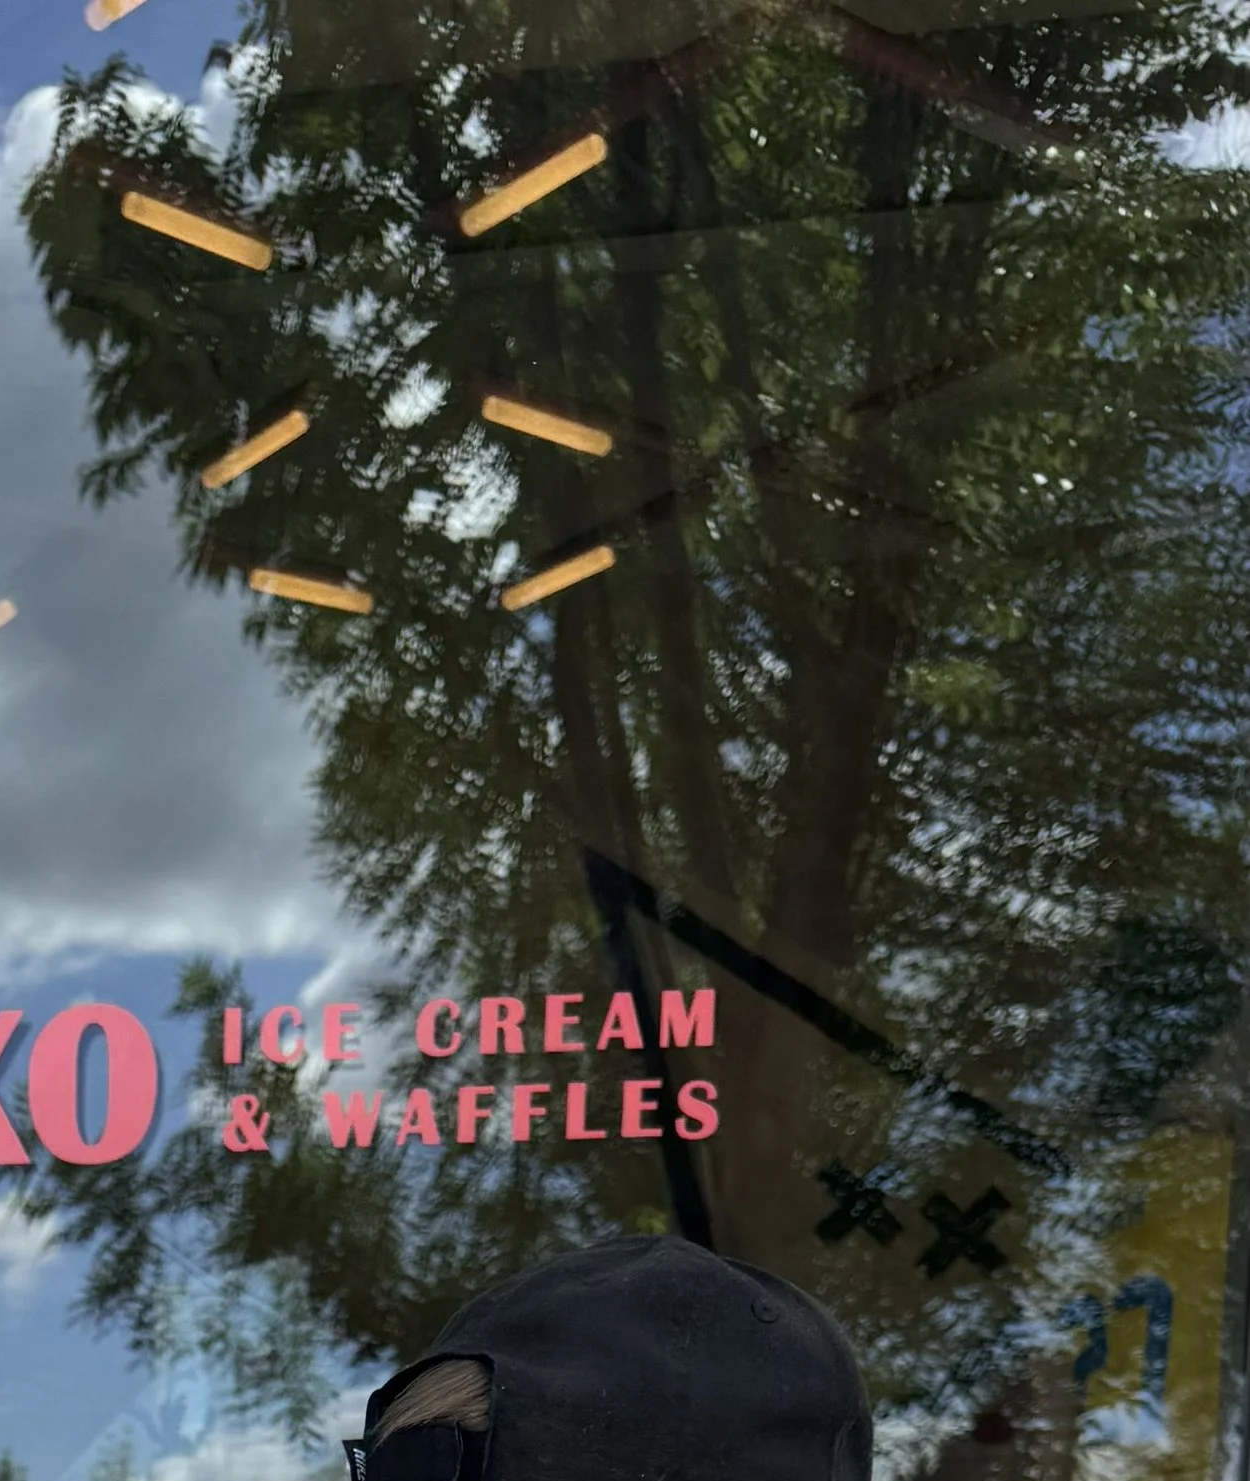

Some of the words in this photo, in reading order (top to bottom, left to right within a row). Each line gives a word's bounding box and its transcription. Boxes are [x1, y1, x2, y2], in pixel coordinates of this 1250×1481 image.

[223, 1002, 361, 1064] ICE
[415, 989, 716, 1057] CREAM
[222, 1094, 270, 1152] &
[323, 1080, 719, 1148] WAFFLES
